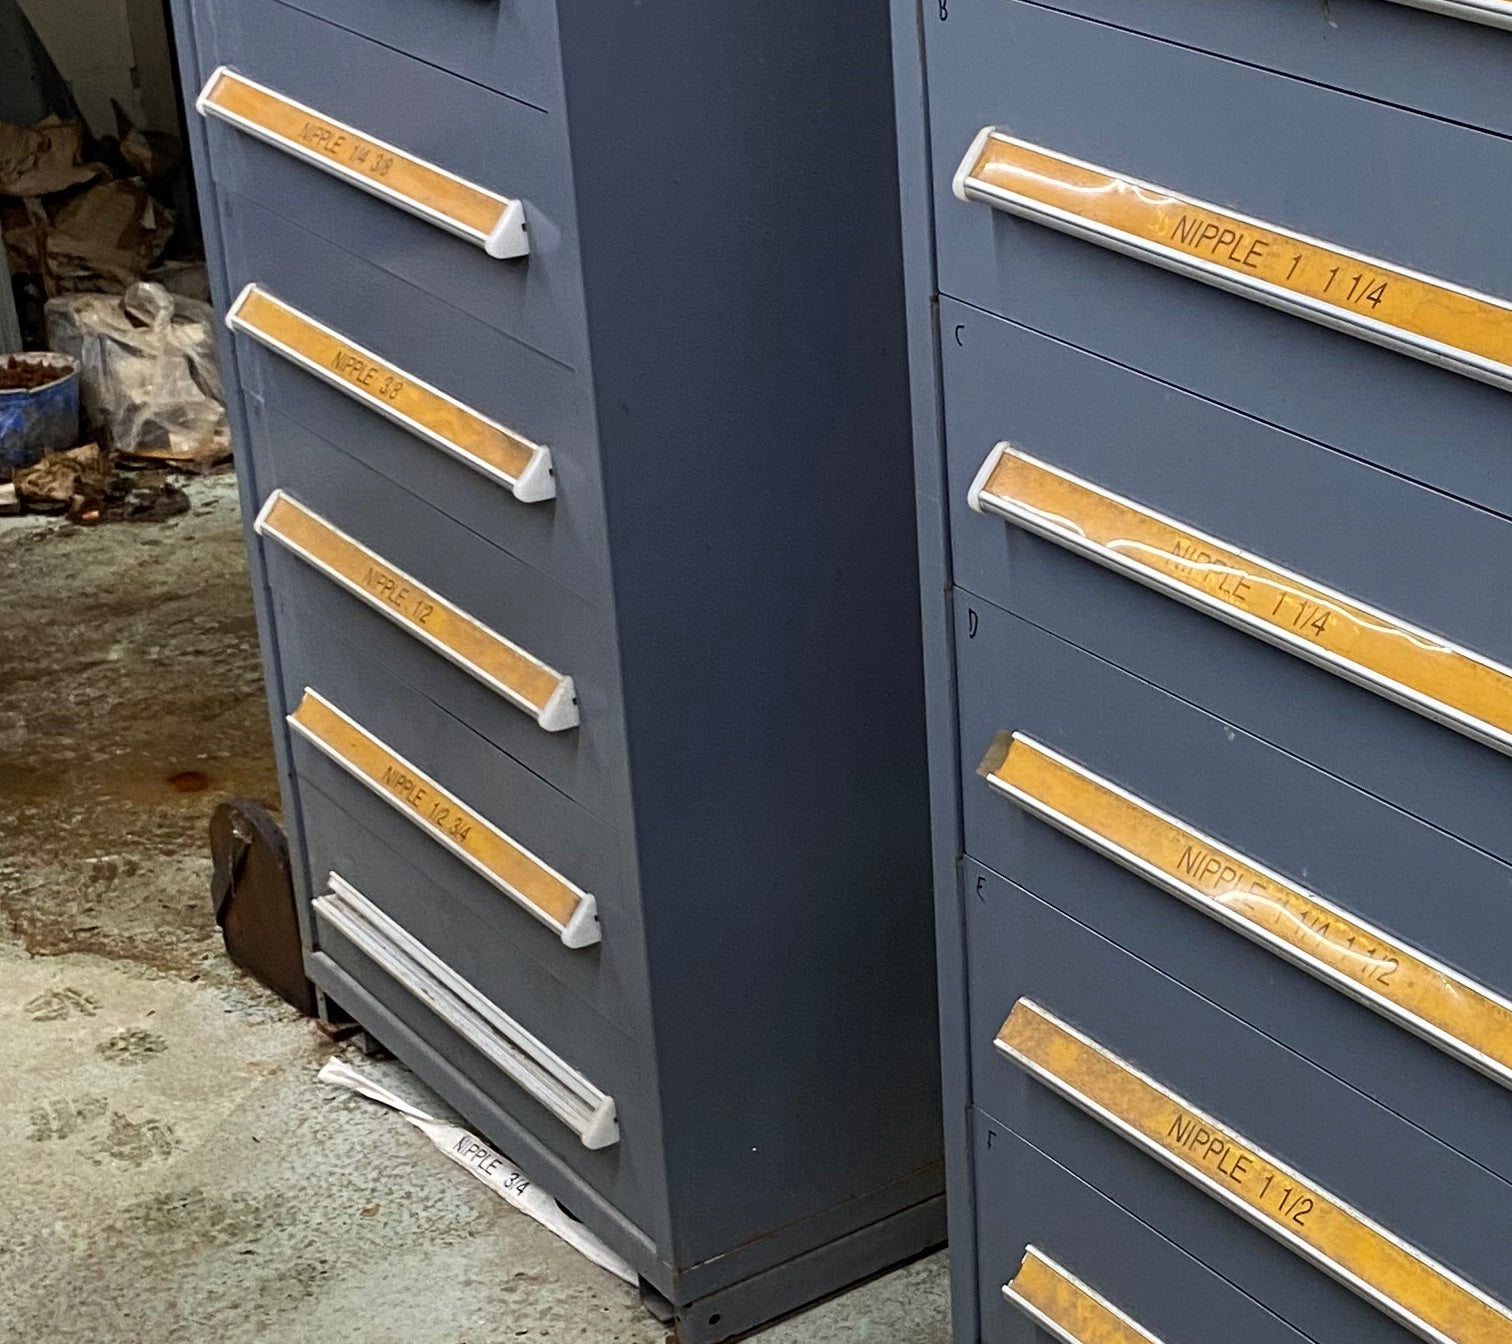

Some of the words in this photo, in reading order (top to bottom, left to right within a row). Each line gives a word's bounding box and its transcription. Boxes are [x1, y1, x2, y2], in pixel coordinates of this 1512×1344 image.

[299, 122, 347, 154] NIPPLE
[1171, 214, 1270, 268] NIPPLE
[1285, 254, 1304, 282] 1
[1346, 273, 1389, 311] 1/4
[955, 324, 965, 347] C
[331, 351, 378, 386] NIPPLE
[363, 567, 409, 606] NIPPLE
[968, 607, 979, 639] D
[382, 766, 426, 808] NIPPLE
[453, 1136, 503, 1175] NIPPLE
[504, 1172, 531, 1196] 3/4
[1167, 1115, 1252, 1186] NIPPLE
[1259, 1175, 1276, 1201] 1
[1279, 1187, 1316, 1227] 1/2
